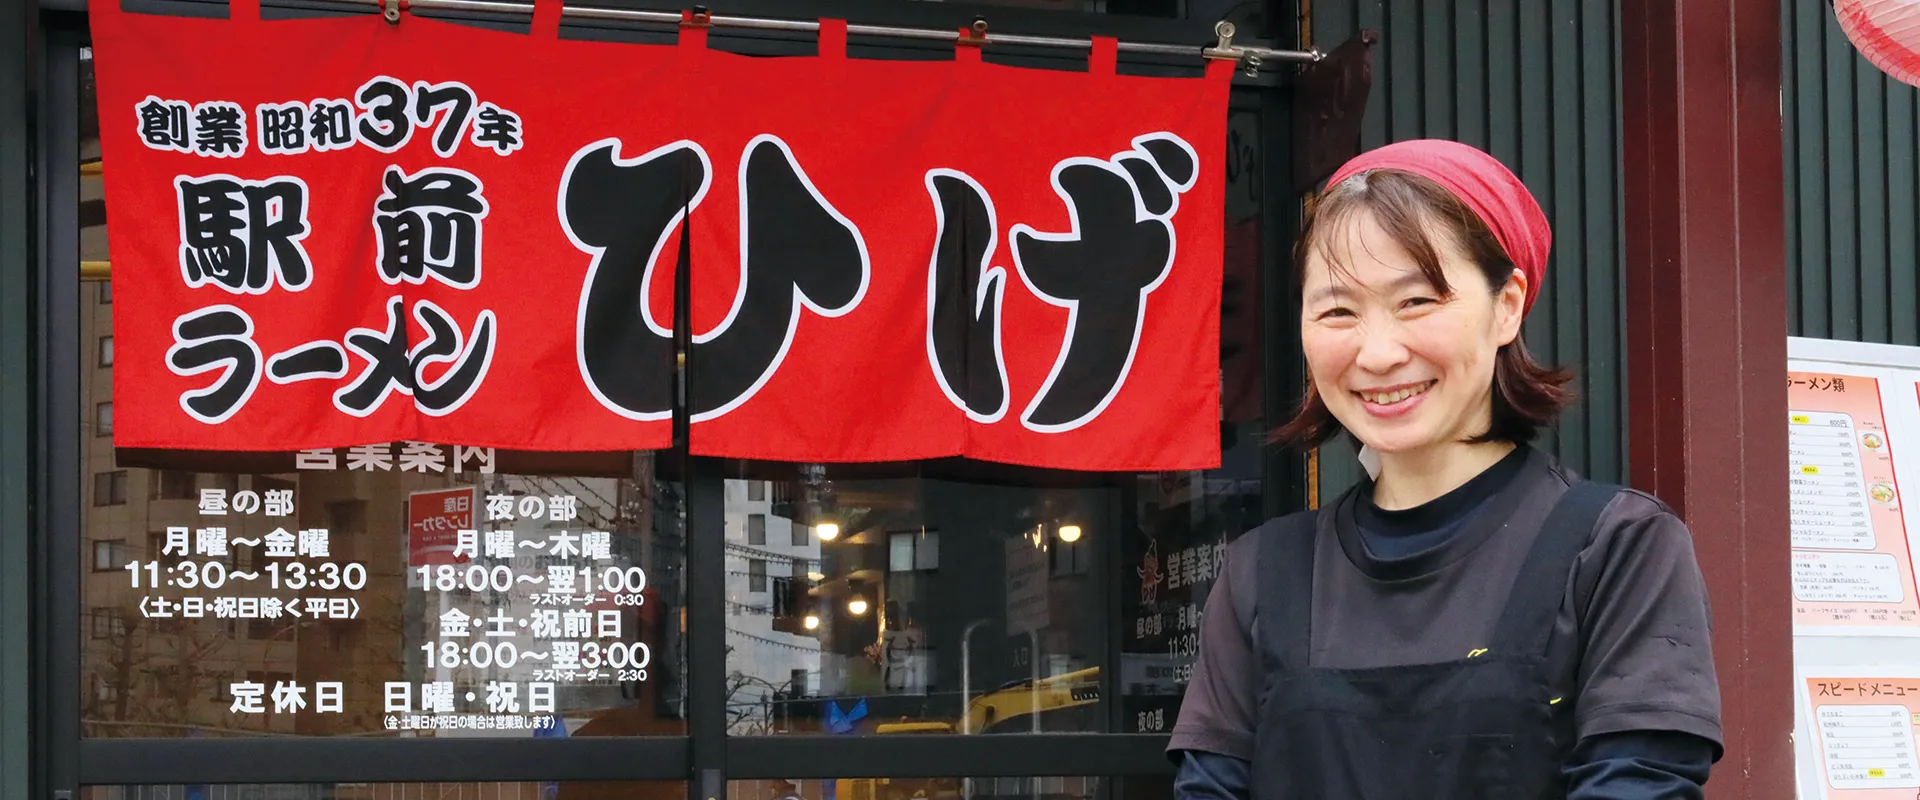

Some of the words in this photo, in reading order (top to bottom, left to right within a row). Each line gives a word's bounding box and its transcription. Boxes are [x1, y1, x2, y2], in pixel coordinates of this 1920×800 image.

[137, 97, 245, 157] 創業
[257, 75, 523, 158] 昭和37年
[173, 165, 488, 294] 駅前
[557, 134, 1199, 433] ひげ
[165, 296, 497, 424] ラーメン
[198, 489, 294, 516] 昼の部
[486, 494, 577, 521] 夜の部
[529, 594, 606, 606] ラストオーダー
[614, 594, 644, 606] 0:30
[439, 608, 622, 638] 金・土・祝前日
[1136, 613, 1162, 639] 昼の部
[532, 670, 609, 682] ラストオーダー
[618, 670, 647, 682] 2:30
[1818, 682, 1918, 697] スピードメニュー
[229, 681, 344, 714] 定休日
[383, 681, 555, 713] 日曜・祝日
[1138, 708, 1164, 732] 夜の部
